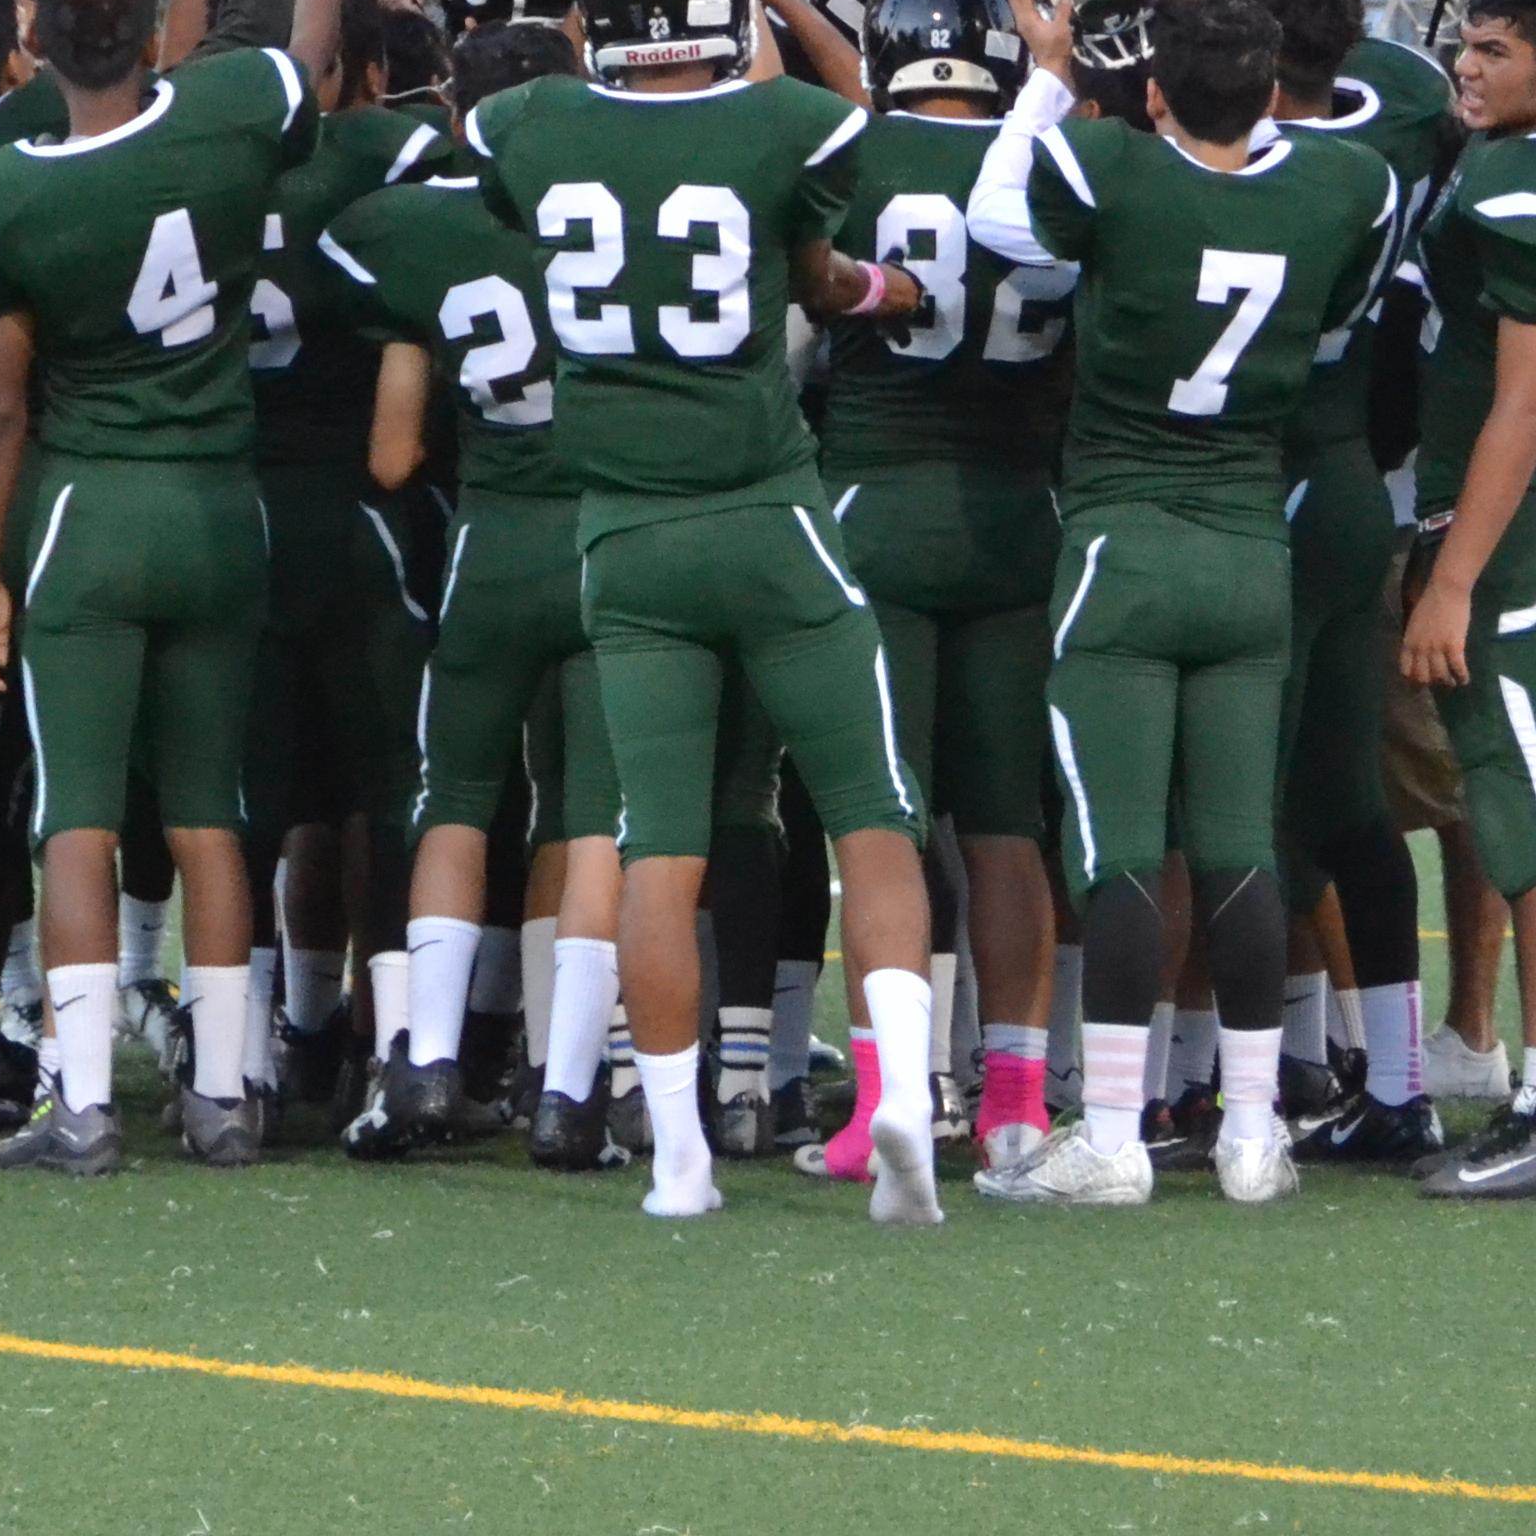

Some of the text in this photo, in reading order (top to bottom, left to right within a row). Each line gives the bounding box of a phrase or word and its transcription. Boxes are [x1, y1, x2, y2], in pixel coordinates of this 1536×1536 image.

[626, 44, 702, 64] Riddell
[648, 17, 670, 39] 23
[930, 29, 951, 49] 82
[127, 207, 219, 348] 4
[536, 181, 751, 357] 23
[1167, 248, 1287, 416] 7
[438, 275, 554, 425] 2
